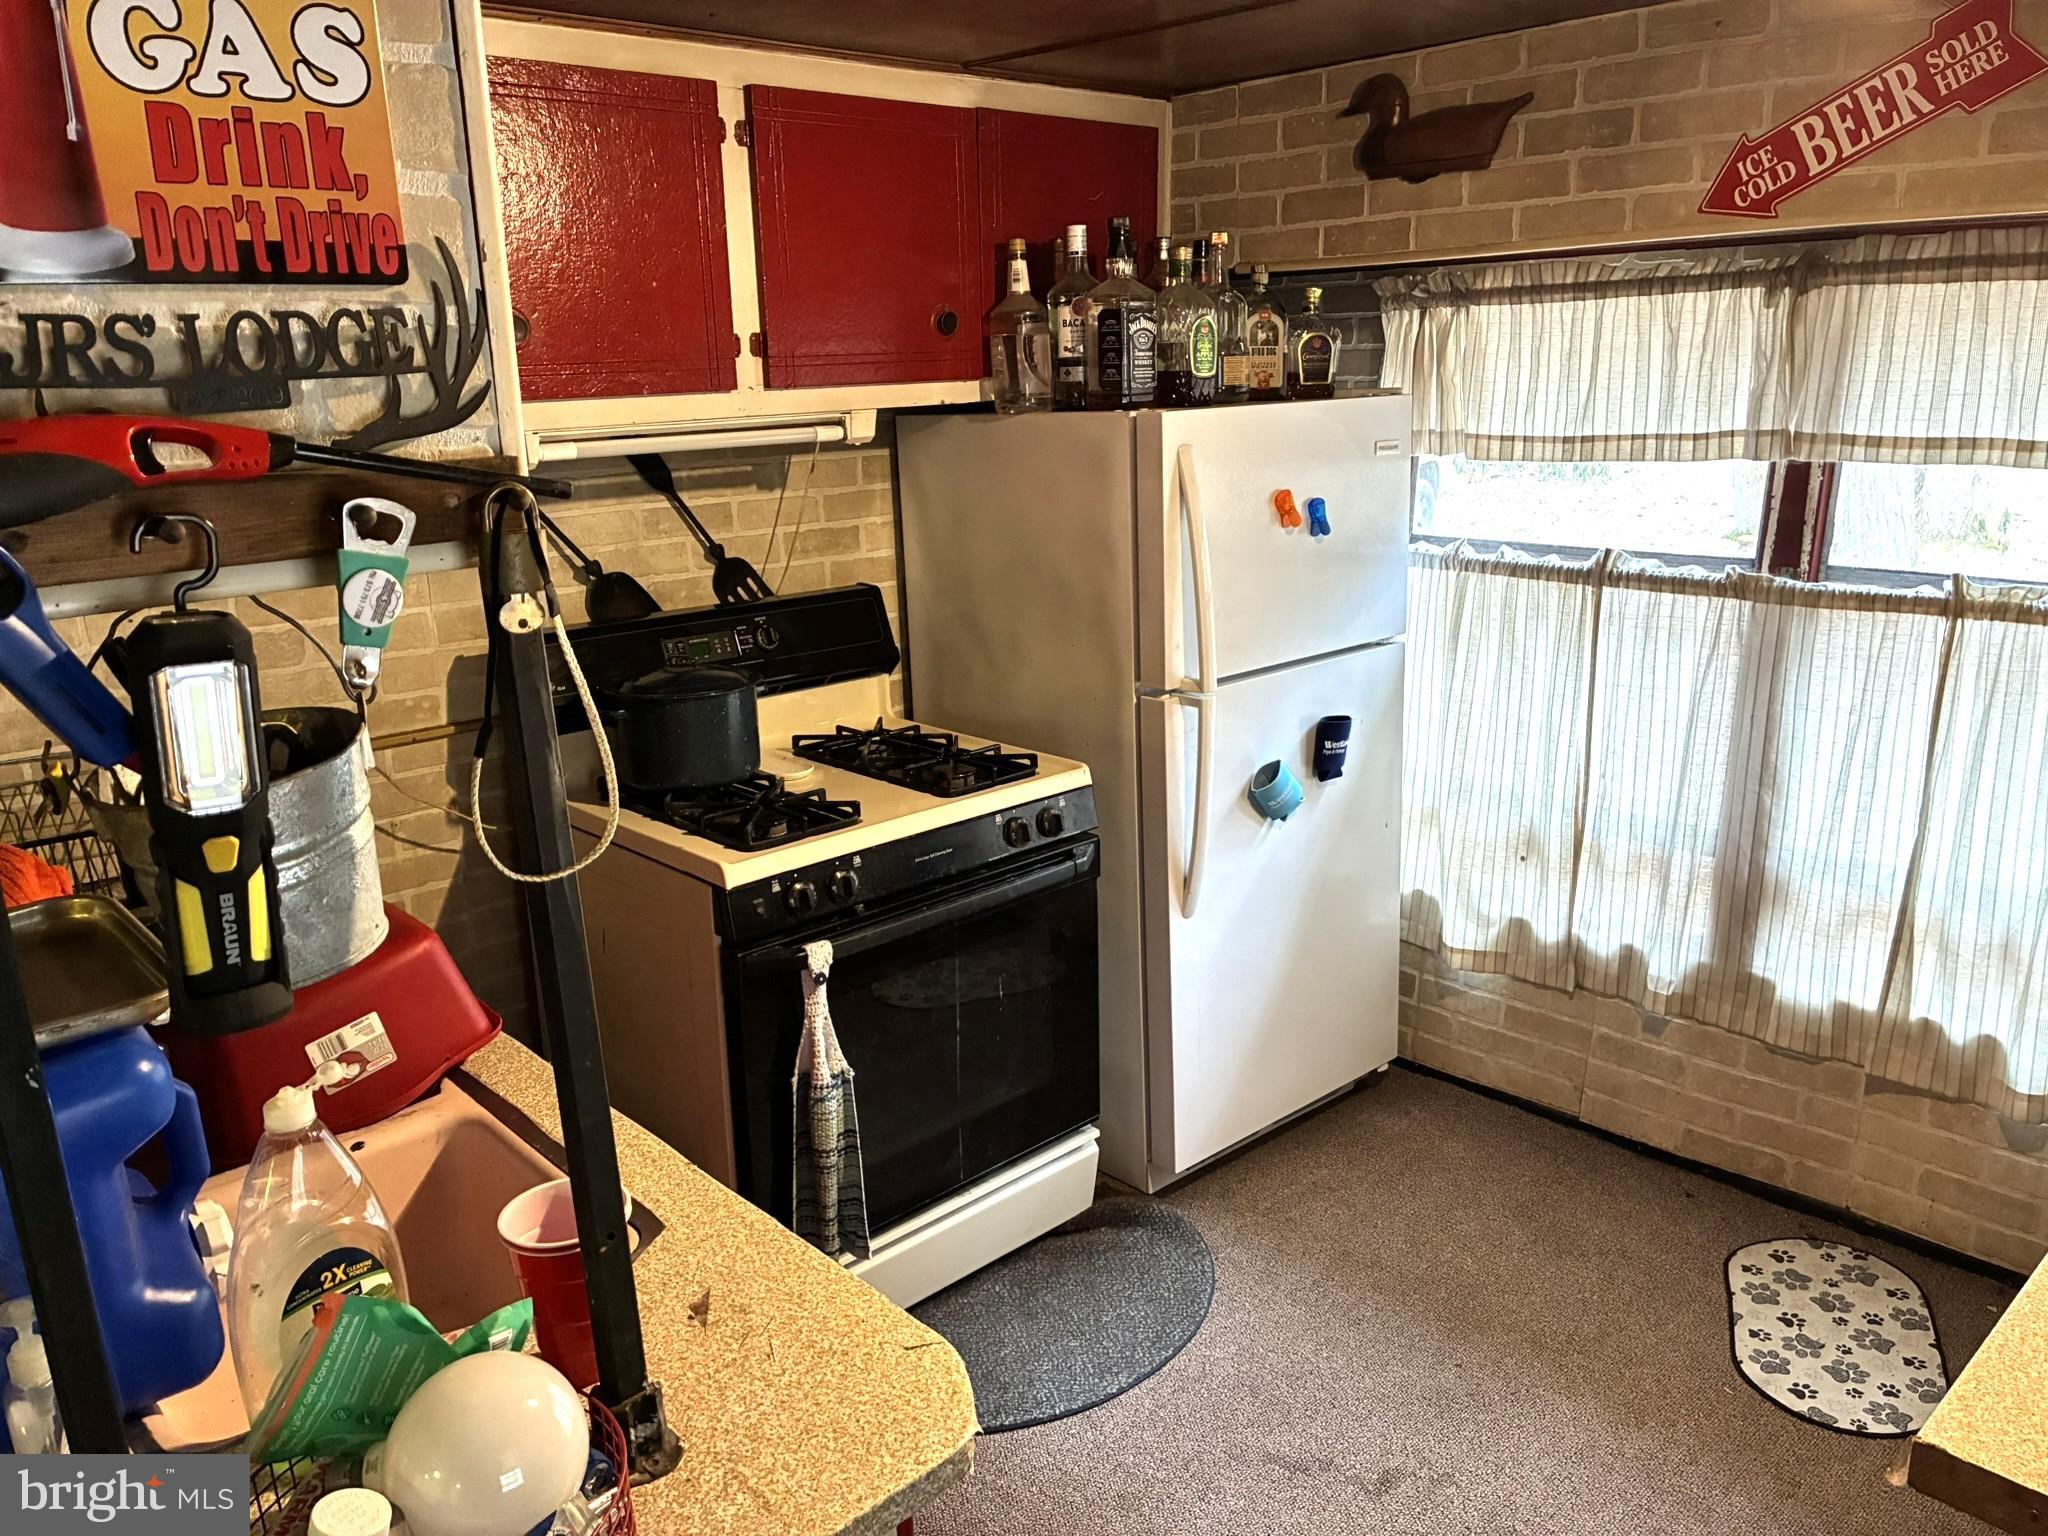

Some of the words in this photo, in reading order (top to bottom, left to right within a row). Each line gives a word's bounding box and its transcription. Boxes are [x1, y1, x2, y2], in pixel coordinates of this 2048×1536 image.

[86, 0, 371, 107] GAS
[1925, 19, 1999, 75] SOLD
[1932, 39, 2010, 96] HERE
[1790, 61, 1936, 177] BEER
[144, 100, 369, 201] Drink,
[1735, 144, 1779, 182] ICE
[1733, 160, 1798, 208] COLD
[135, 190, 272, 273] Don't
[275, 196, 400, 276] Drive
[177, 307, 415, 380] LODGE
[1062, 319, 1085, 328] BACA
[218, 891, 242, 968] BRAUN
[320, 1263, 347, 1290] 2X
[346, 1259, 373, 1273] CLEANING
[315, 1358, 331, 1384] care
